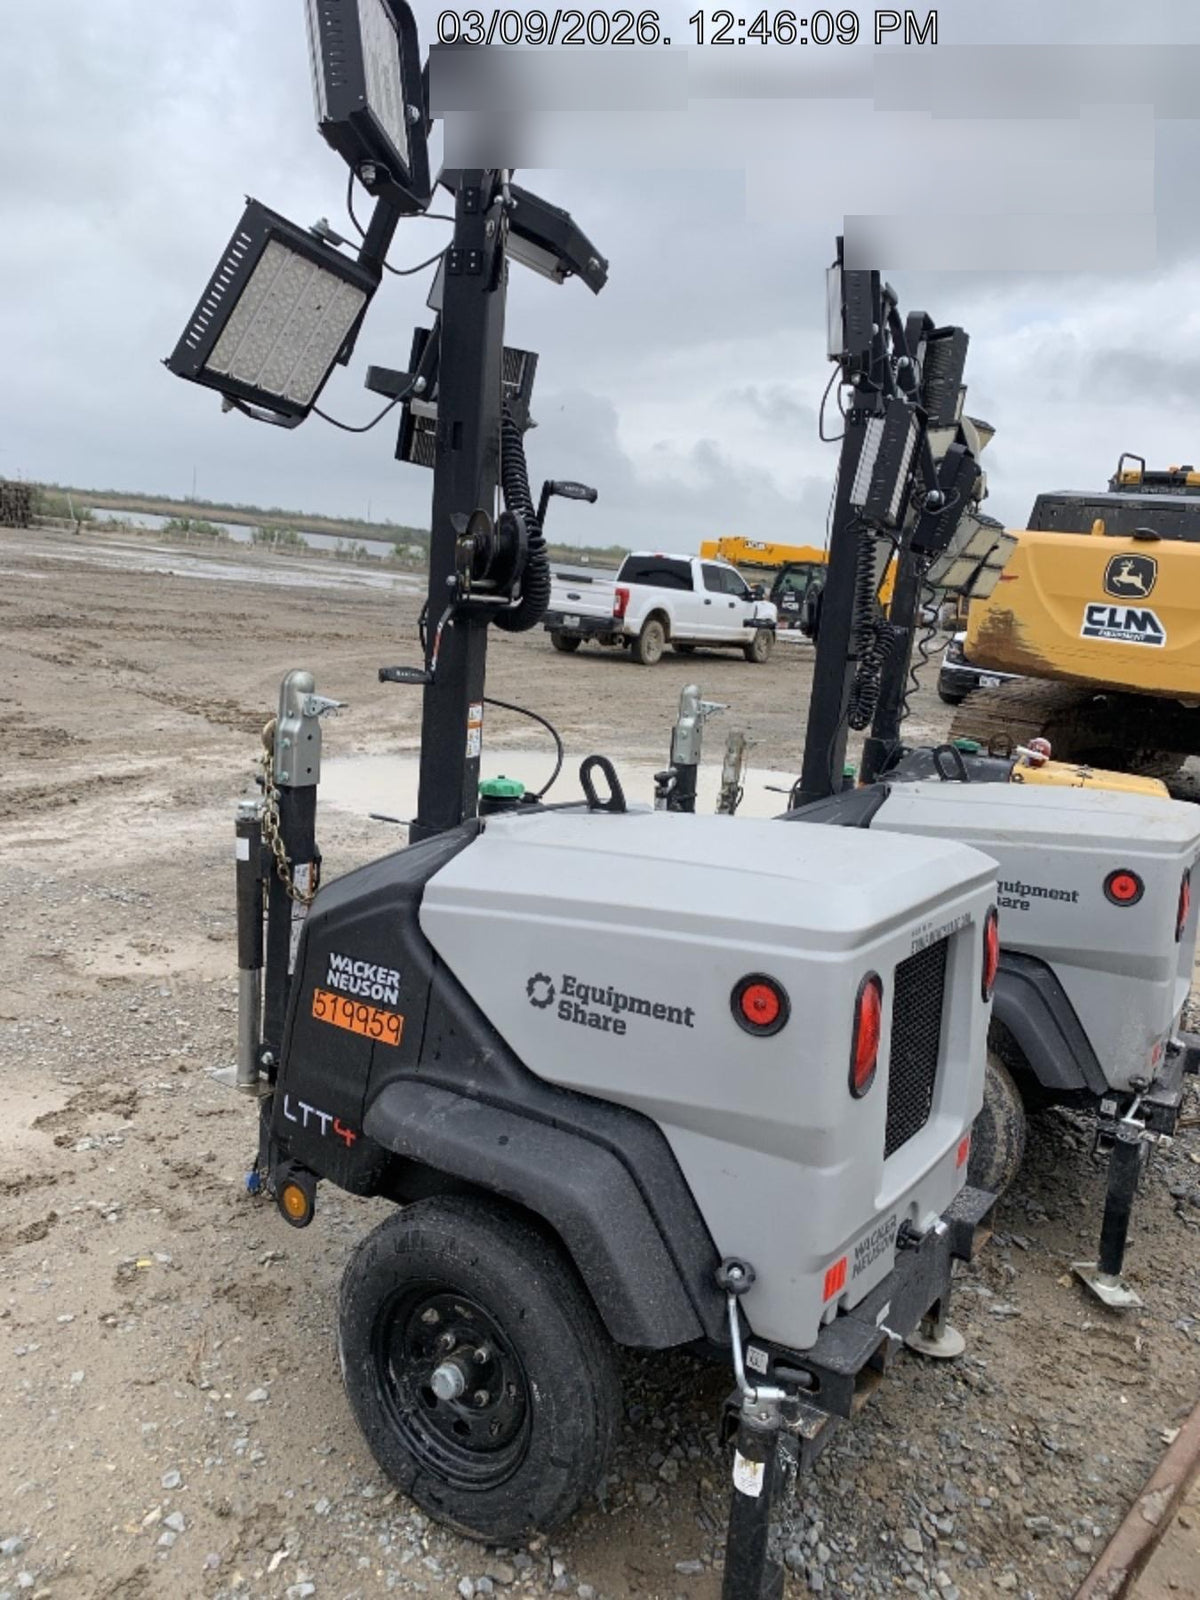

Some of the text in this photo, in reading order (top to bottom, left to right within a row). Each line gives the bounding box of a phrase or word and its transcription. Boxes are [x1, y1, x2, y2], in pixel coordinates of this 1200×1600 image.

[1087, 606, 1162, 633] CLM
[326, 969, 399, 1005] NEUSON
[329, 952, 401, 988] WACKER
[314, 991, 401, 1043] 519959
[557, 999, 627, 1036] Share
[560, 973, 695, 1028] Equipment
